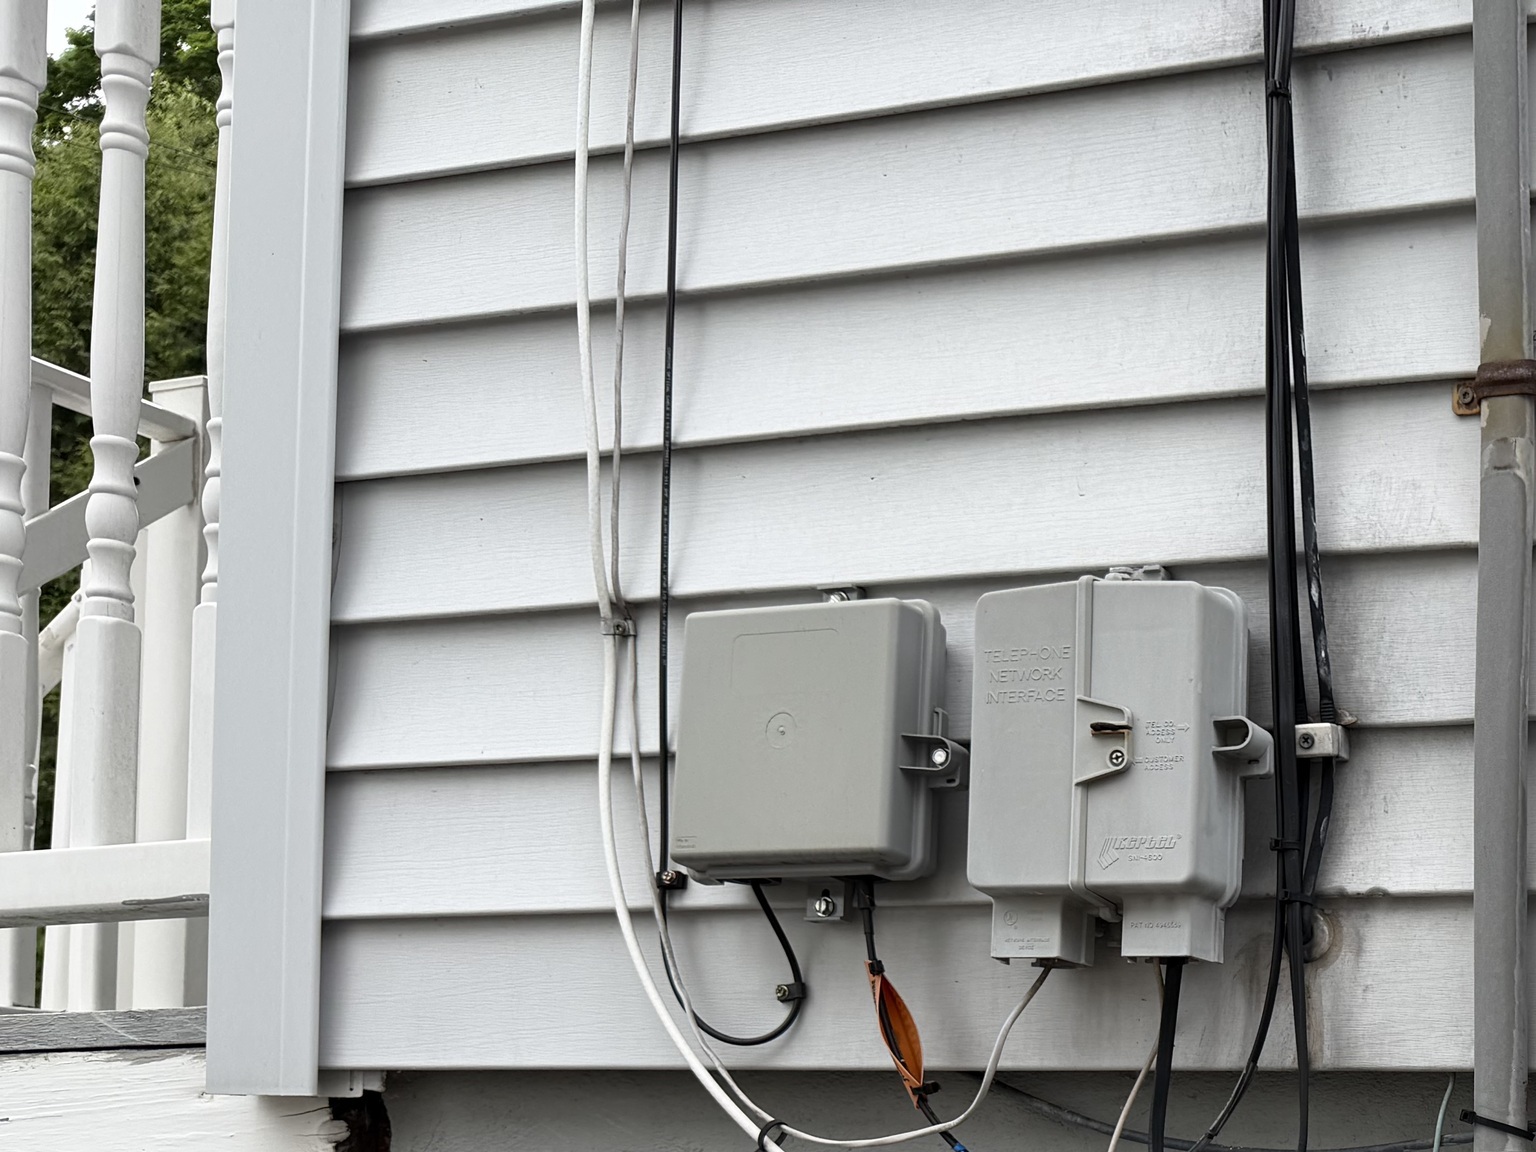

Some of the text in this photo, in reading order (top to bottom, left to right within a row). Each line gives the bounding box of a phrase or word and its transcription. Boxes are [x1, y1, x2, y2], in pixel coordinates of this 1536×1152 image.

[984, 646, 1071, 663] TELEPHONE
[989, 667, 1063, 683] NETWORK
[986, 688, 1066, 704] INTERFACE
[1144, 755, 1184, 763] CUSTOMER
